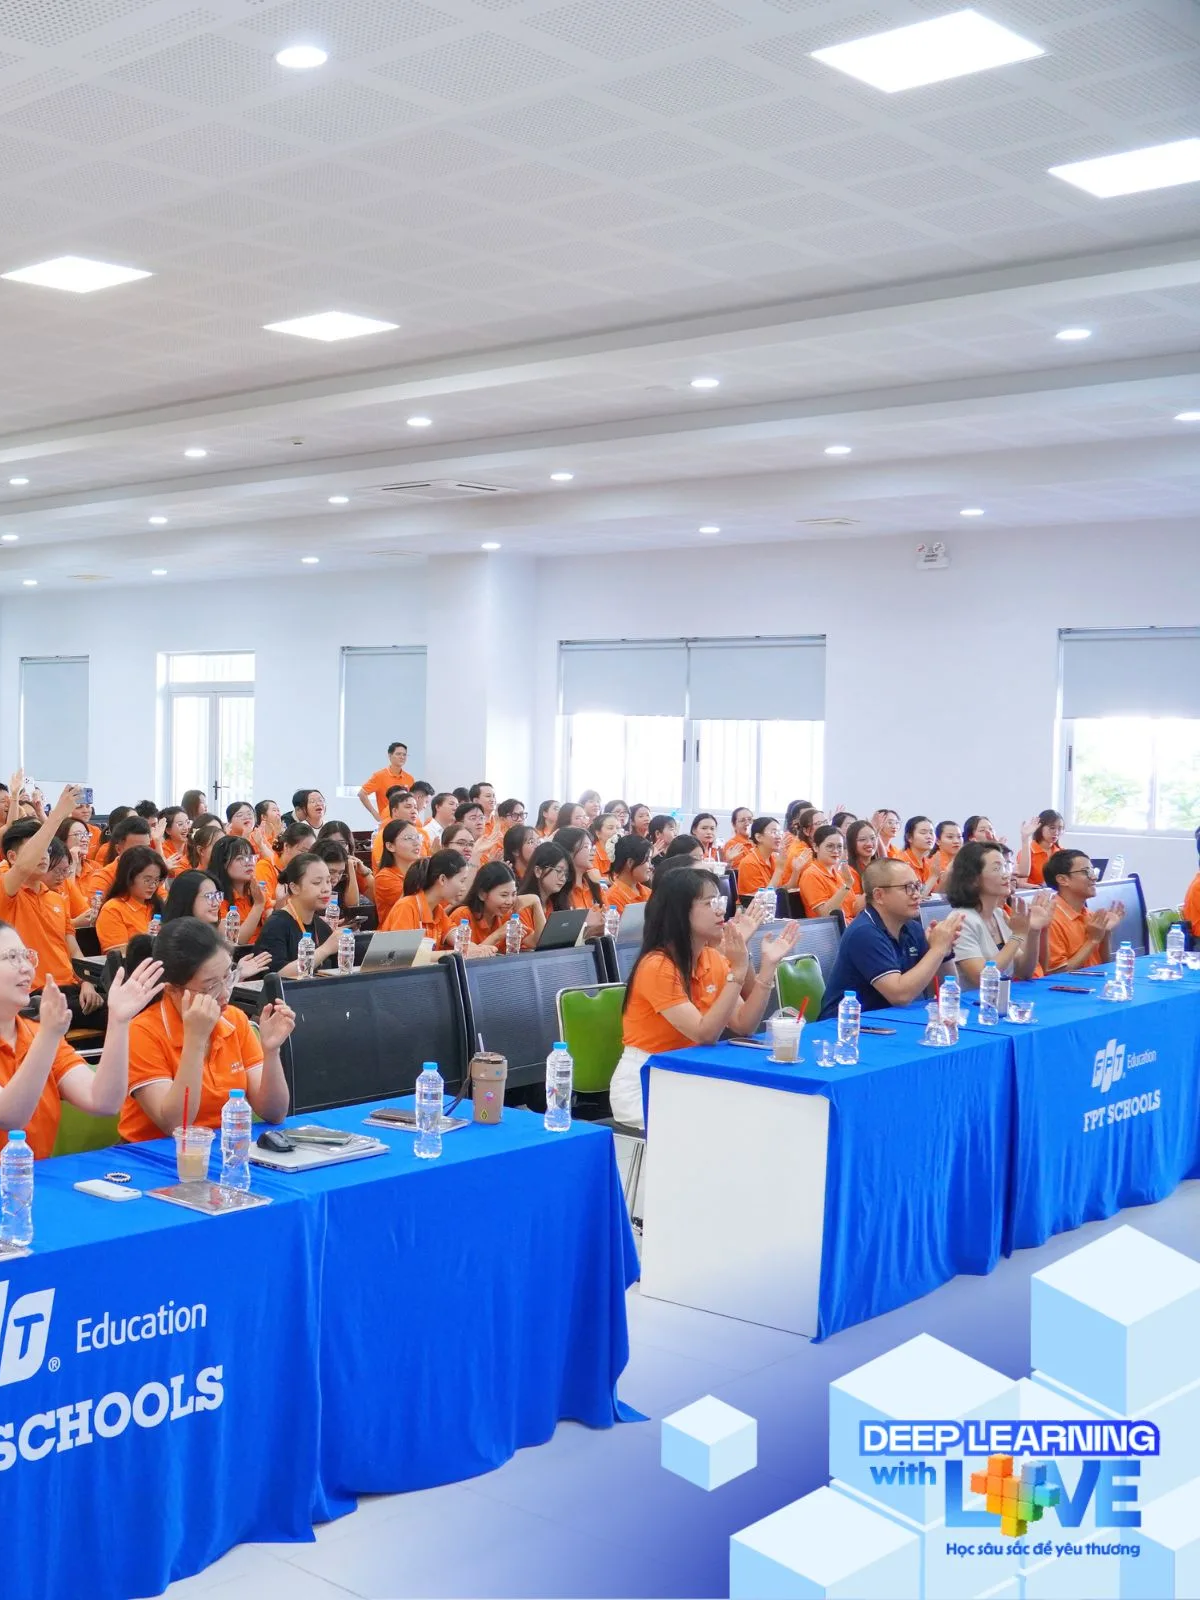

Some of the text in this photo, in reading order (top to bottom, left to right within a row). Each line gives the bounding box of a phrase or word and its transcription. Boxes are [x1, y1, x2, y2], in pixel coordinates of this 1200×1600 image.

[1126, 1049, 1157, 1069] Education
[1082, 1089, 1161, 1133] FPT SCHOOLS
[75, 1300, 207, 1353] Education
